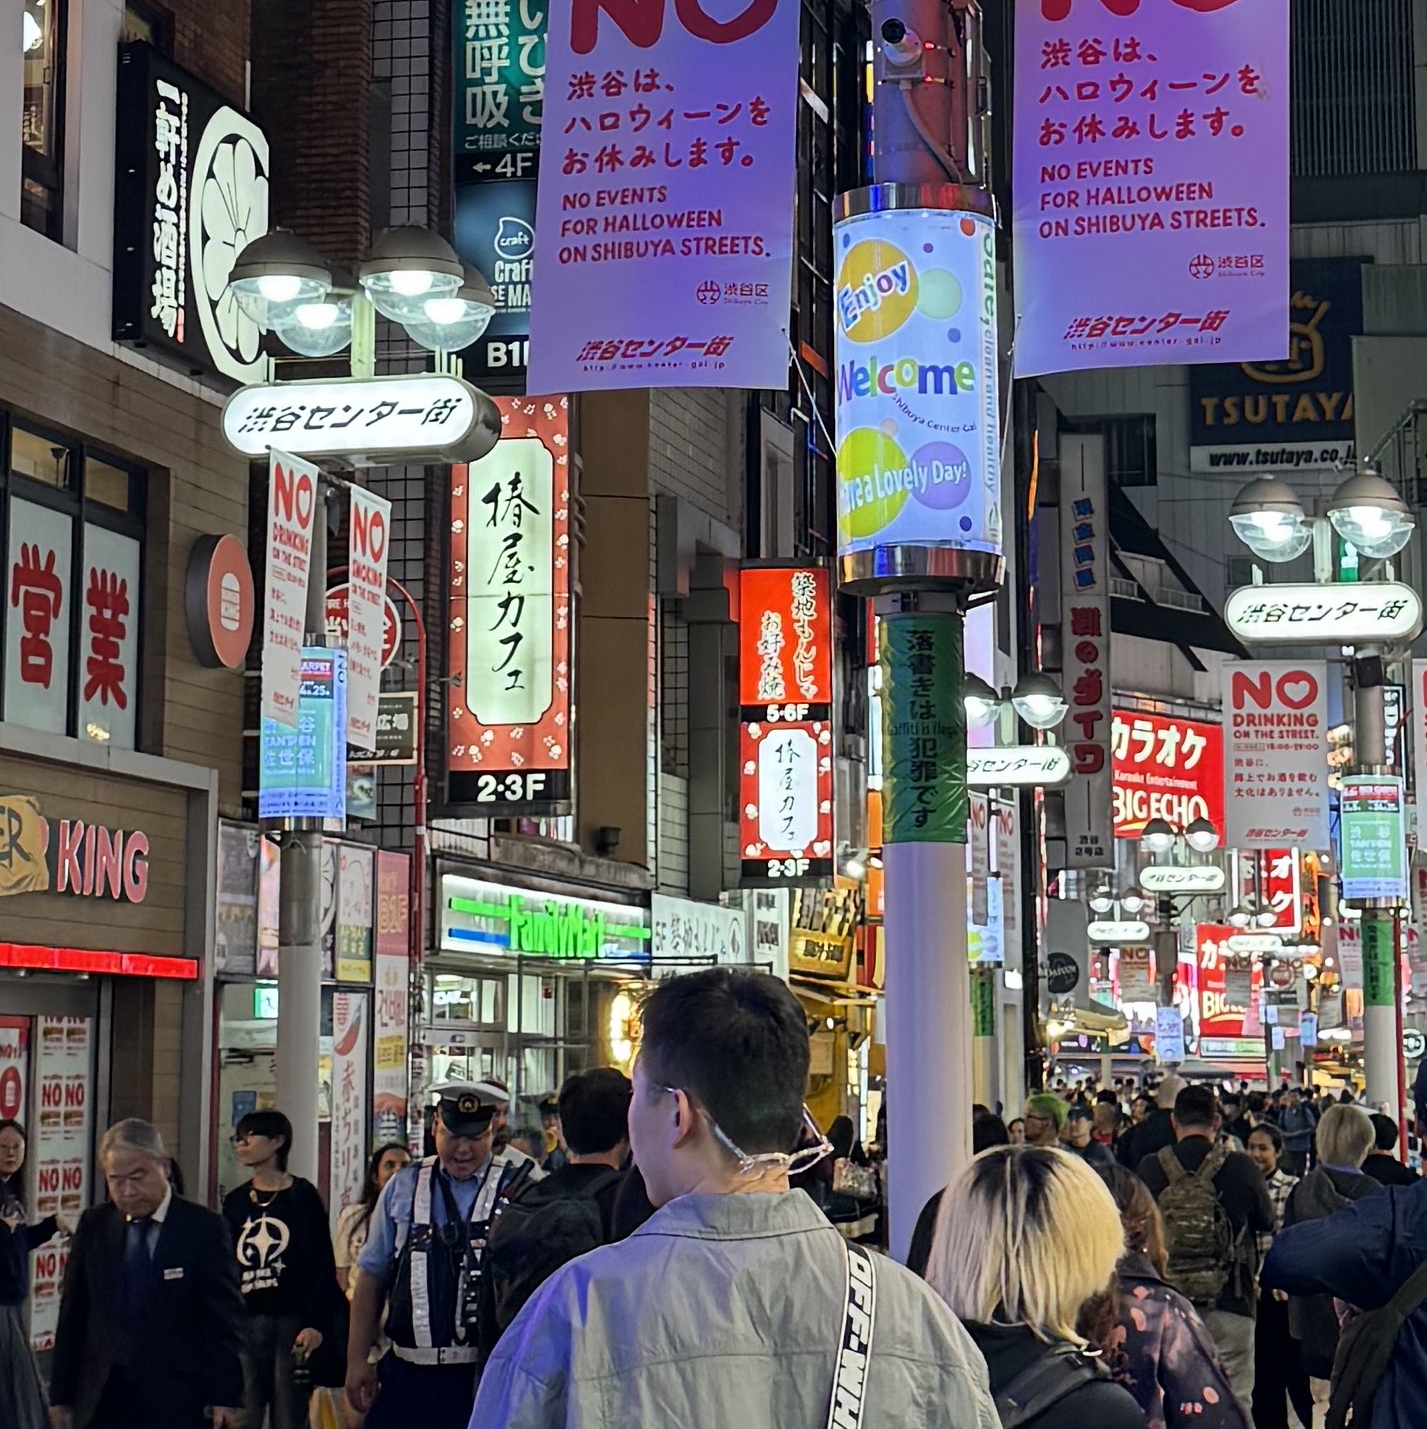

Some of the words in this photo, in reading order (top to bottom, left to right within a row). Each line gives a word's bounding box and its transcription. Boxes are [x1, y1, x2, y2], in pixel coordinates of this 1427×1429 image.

[1040, 36, 1159, 70] 渋谷は、
[566, 67, 675, 102] 渋谷は、
[1038, 64, 1262, 104] ハロウィーンを
[563, 95, 772, 136] ハロウィーンを
[1038, 106, 1246, 147] お休みします。
[494, 154, 534, 178] 4F
[561, 136, 755, 176] お休みします。
[1040, 163, 1071, 184] NO
[1076, 157, 1154, 181] EVENTS
[151, 79, 180, 339] 一軒め酒場
[563, 192, 592, 212] NO
[596, 185, 668, 208] EVENTS
[1040, 191, 1080, 212] FOR
[1086, 181, 1214, 206] HALLOWEEN
[560, 217, 599, 238] FOR
[603, 209, 723, 235] HALLOWEEN
[1038, 217, 1070, 239] ON
[1074, 212, 1166, 235] SHIBUYA
[1170, 206, 1267, 230] STREETS.
[500, 234, 529, 247] craft
[558, 243, 587, 266] ON
[591, 237, 674, 262] SHIBUYA
[680, 235, 772, 259] STREETS.
[1218, 254, 1265, 270] 渋谷区
[723, 282, 770, 299] 渋谷区
[838, 259, 911, 330] Enjoy
[1062, 309, 1231, 340] 渋谷センター街
[575, 334, 734, 364] 渋谷センター街
[838, 356, 976, 407] Welcome
[238, 398, 463, 434] 渋谷センター街
[274, 461, 313, 530] NO
[874, 462, 928, 500] Lovely
[931, 459, 968, 485] Day!
[353, 501, 385, 564] NO
[481, 471, 541, 692] 椿屋カフェ
[12, 542, 129, 710] 営業
[1237, 599, 1411, 626] 渋谷センター街
[757, 610, 786, 701] お好み焼
[1232, 670, 1319, 710] NO
[906, 629, 940, 830] 落書きは犯罪です
[1232, 713, 1319, 727] DRINKING
[1233, 729, 1251, 739] ON
[1254, 729, 1275, 739] THE
[1278, 729, 1320, 740] STREET.
[1111, 715, 1207, 771] カラオケ
[774, 737, 802, 842] 椿屋カフェ
[1112, 786, 1148, 823] BIG
[1149, 790, 1210, 826] ECHO
[56, 819, 149, 904] KING
[509, 893, 605, 960] FamilyMart
[42, 1082, 62, 1108] NO
[65, 1082, 85, 1107] NO
[38, 1167, 59, 1193] NO
[62, 1166, 82, 1191] NO
[35, 1253, 56, 1280] NO
